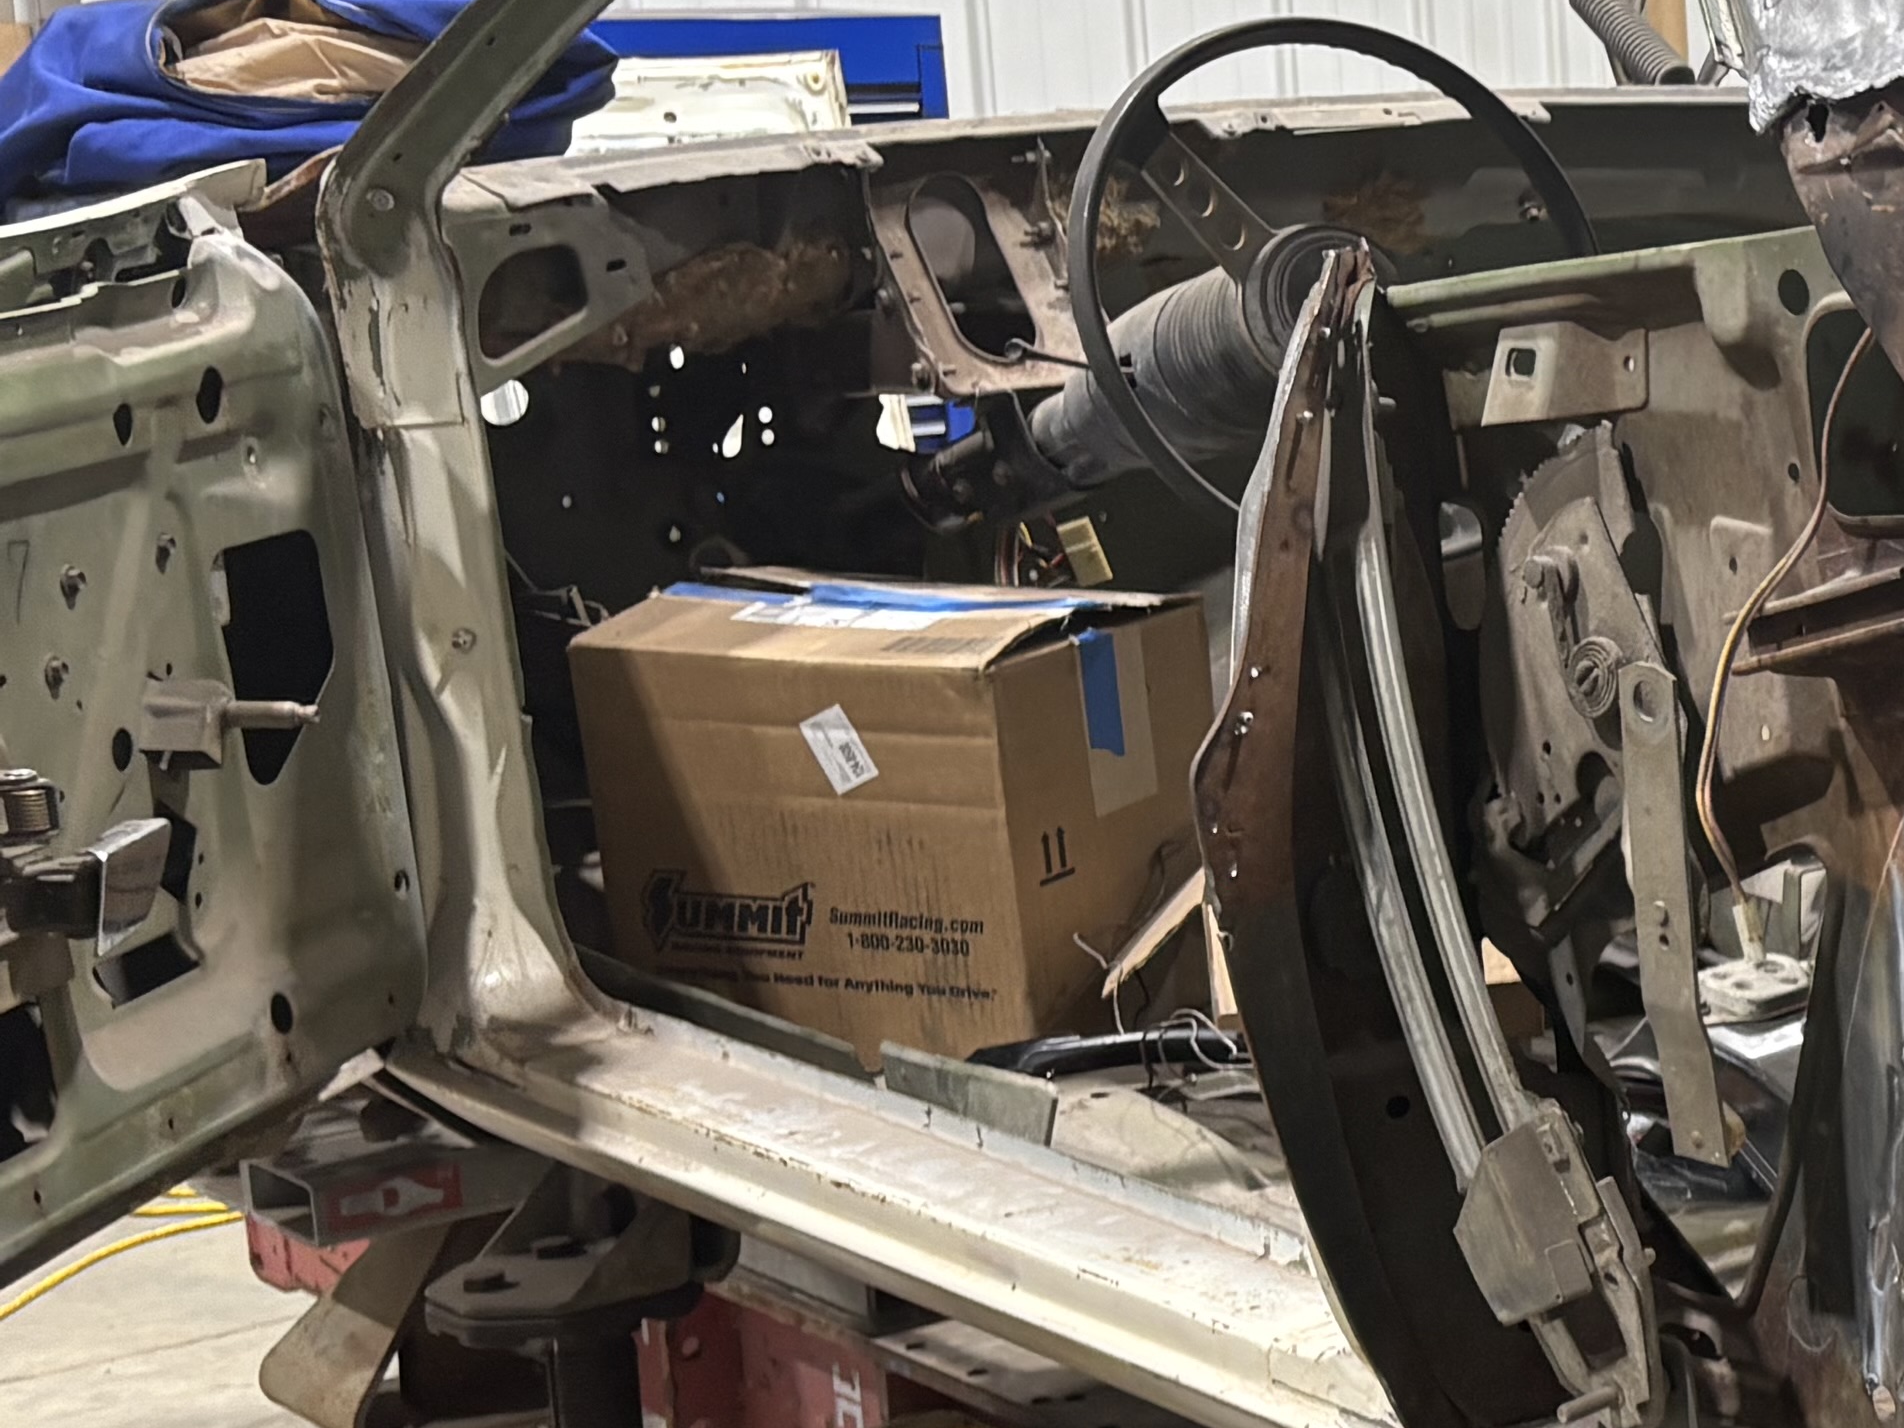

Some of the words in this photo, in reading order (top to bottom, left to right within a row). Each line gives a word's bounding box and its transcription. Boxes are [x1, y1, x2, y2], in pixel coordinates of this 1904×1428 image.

[830, 906, 984, 935] SummitRacing.com
[848, 932, 970, 957] 1-800-230-3030
[818, 976, 839, 988] for
[845, 977, 914, 996] Anything
[918, 983, 946, 997] You
